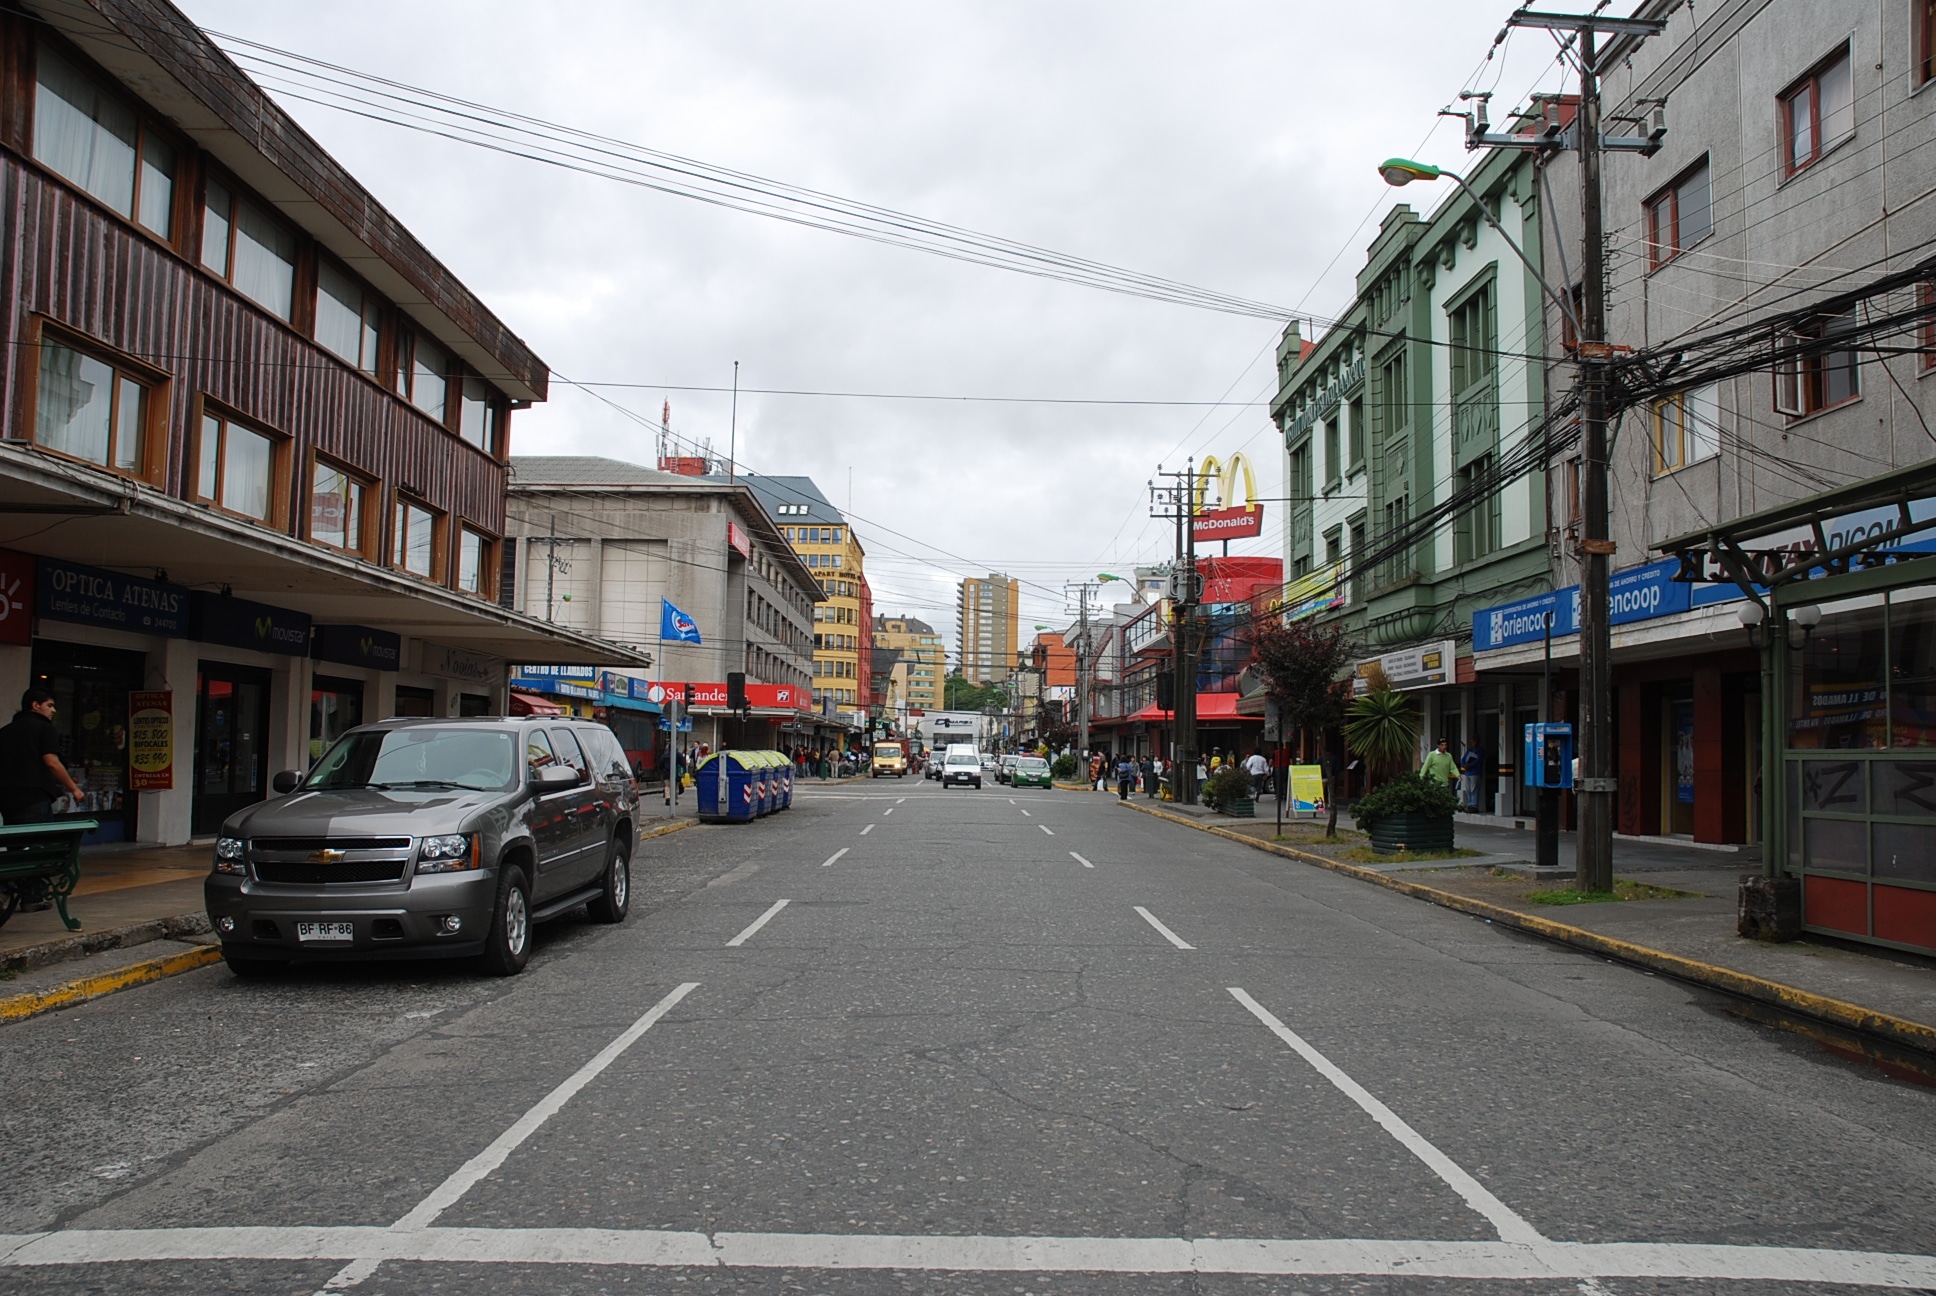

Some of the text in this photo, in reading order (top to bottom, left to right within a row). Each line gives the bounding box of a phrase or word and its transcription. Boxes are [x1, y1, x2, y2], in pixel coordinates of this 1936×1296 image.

[1193, 516, 1255, 531] McDonald's
[51, 594, 126, 622] Lentes de Contacto
[272, 626, 305, 643] movistar
[372, 645, 398, 660] movistar
[524, 665, 593, 677] CENTRO DE LLAMADOS
[666, 687, 728, 701] Sanander
[134, 740, 168, 748] BIFOCALES
[133, 779, 148, 787] 30
